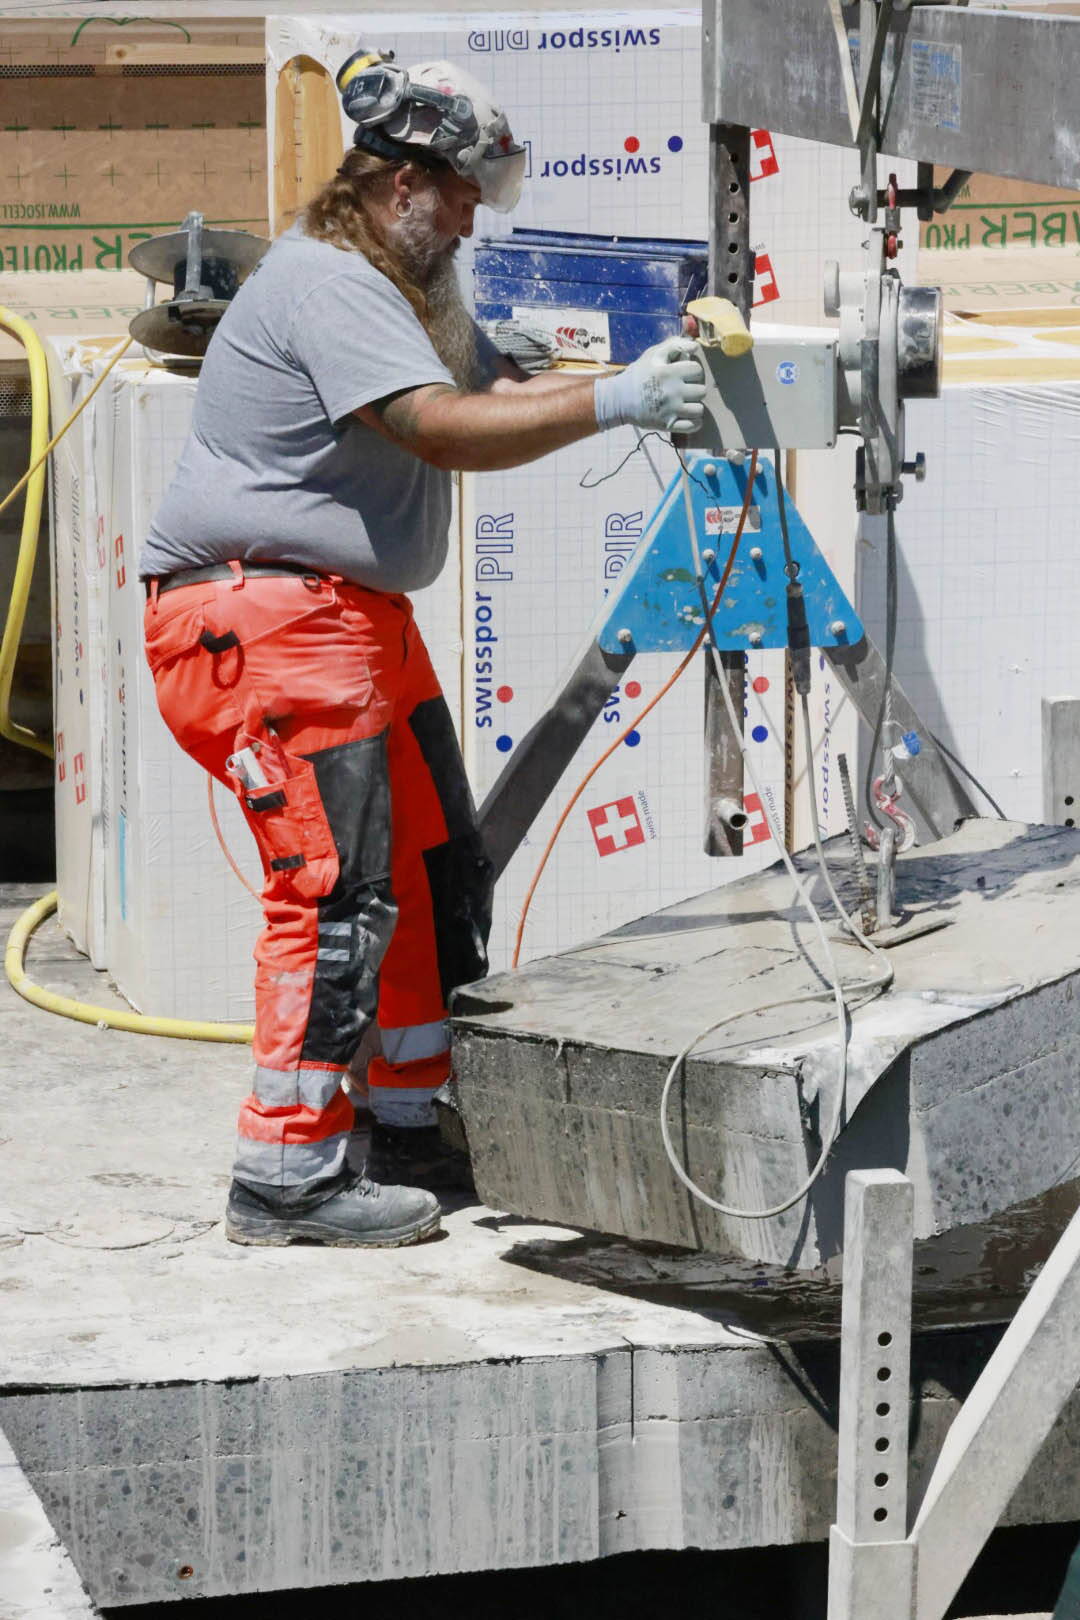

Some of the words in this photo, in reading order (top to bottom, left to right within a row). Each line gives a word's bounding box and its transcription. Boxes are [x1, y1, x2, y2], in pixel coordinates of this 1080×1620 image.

[537, 28, 660, 53] swisspor
[540, 154, 661, 181] swisspor
[475, 512, 514, 582] PIR
[474, 591, 498, 729] swisspor
[821, 682, 832, 820] swisspor
